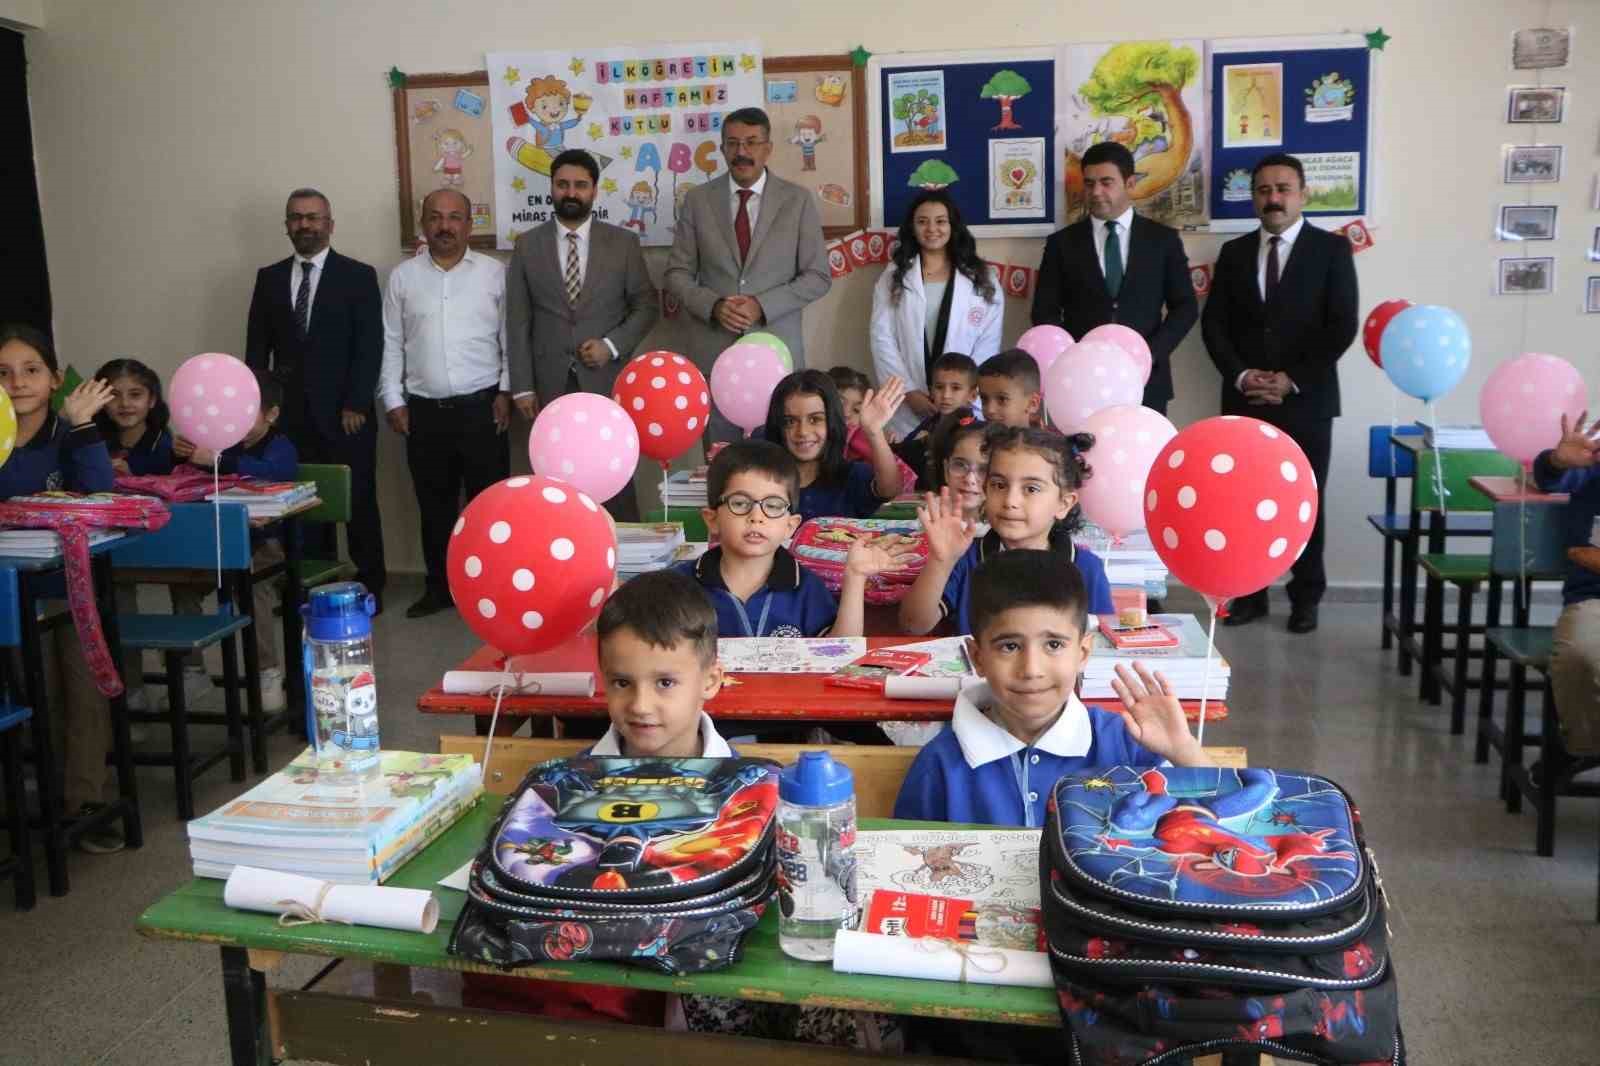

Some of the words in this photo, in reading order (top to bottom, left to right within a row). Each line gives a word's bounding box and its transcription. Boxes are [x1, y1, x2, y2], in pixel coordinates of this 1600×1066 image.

[599, 58, 734, 79] İLKÖĞRETİM
[626, 89, 727, 105] HAFTAMIZ
[611, 119, 669, 131] KUTLU
[687, 117, 720, 130] OLS
[528, 195, 542, 206] EN
[512, 209, 546, 223] MİRAS
